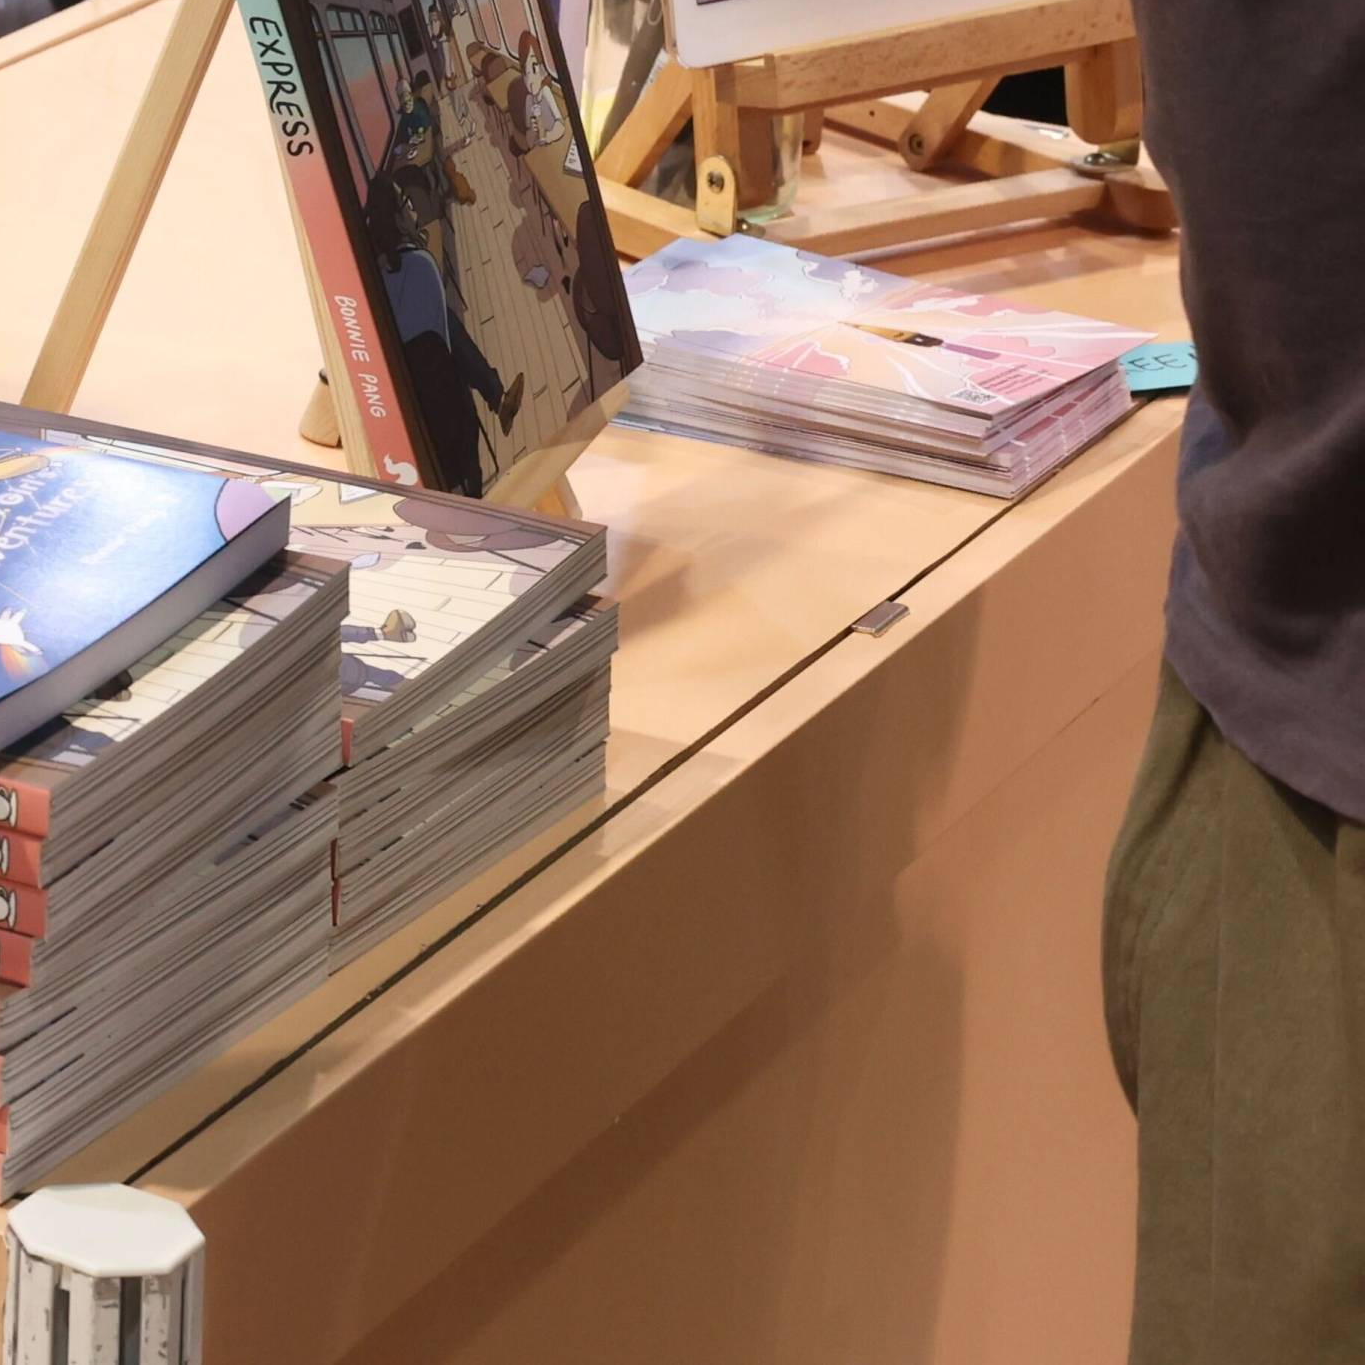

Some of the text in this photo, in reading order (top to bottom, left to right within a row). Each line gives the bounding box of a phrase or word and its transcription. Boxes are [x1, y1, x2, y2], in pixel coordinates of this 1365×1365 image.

[248, 15, 314, 157] EXPRESS
[333, 294, 387, 419] BONNIE PANG
